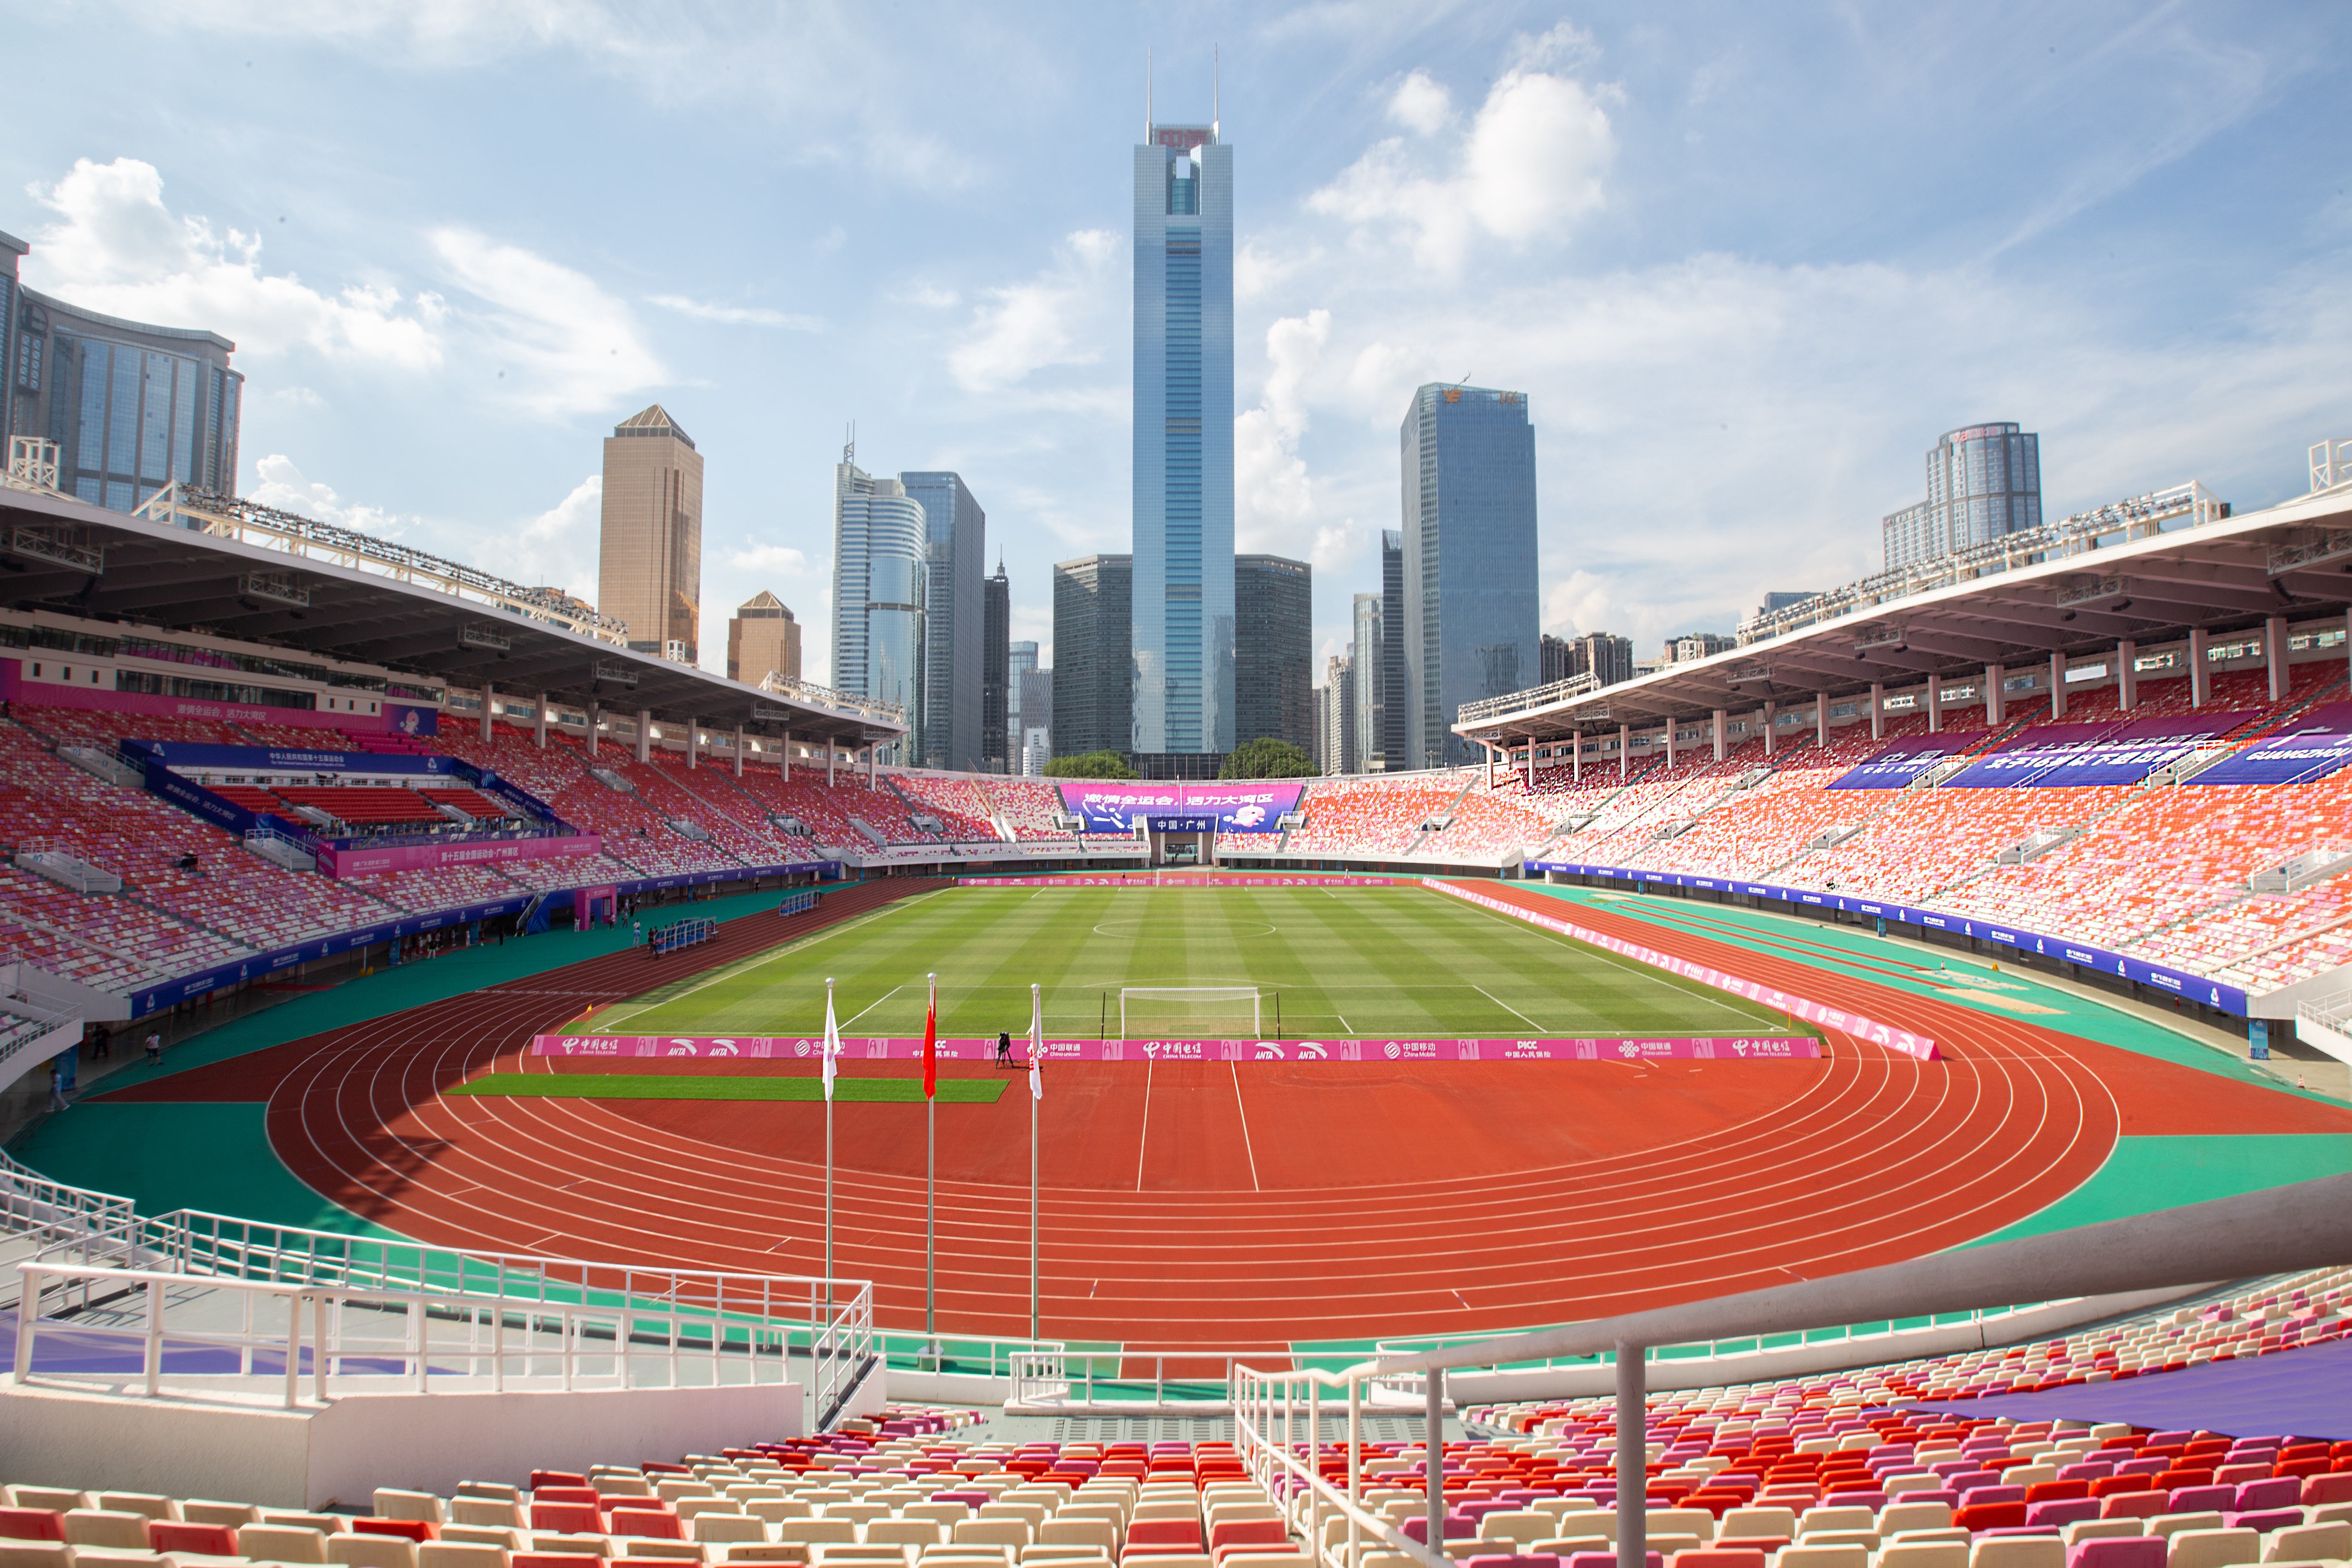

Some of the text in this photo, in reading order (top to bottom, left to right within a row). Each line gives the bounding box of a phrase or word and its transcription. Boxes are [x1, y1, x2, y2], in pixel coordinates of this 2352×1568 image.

[1880, 750, 1944, 766] 中国
[2246, 748, 2352, 760] GUANGZHOU
[1863, 766, 1917, 774] CHINA
[1084, 793, 1274, 806] 激情全运会，活力大湾区
[1158, 820, 1205, 830] 中国·广州
[441, 847, 518, 862] 第十五届全国运动会·广州赛区
[581, 1038, 619, 1050] 中国电信
[1050, 1043, 1081, 1051] 中国联通
[1163, 1042, 1202, 1054] 中国电信
[1403, 1042, 1436, 1051] 中国移动
[1517, 1041, 1537, 1050] PICC
[1641, 1042, 1672, 1050] 中国联通
[1752, 1040, 1790, 1053] 中国电信
[668, 1048, 686, 1056] ANTA
[709, 1048, 727, 1056] ANTA
[1255, 1051, 1273, 1060] ANTA
[1298, 1051, 1316, 1060] ANTA
